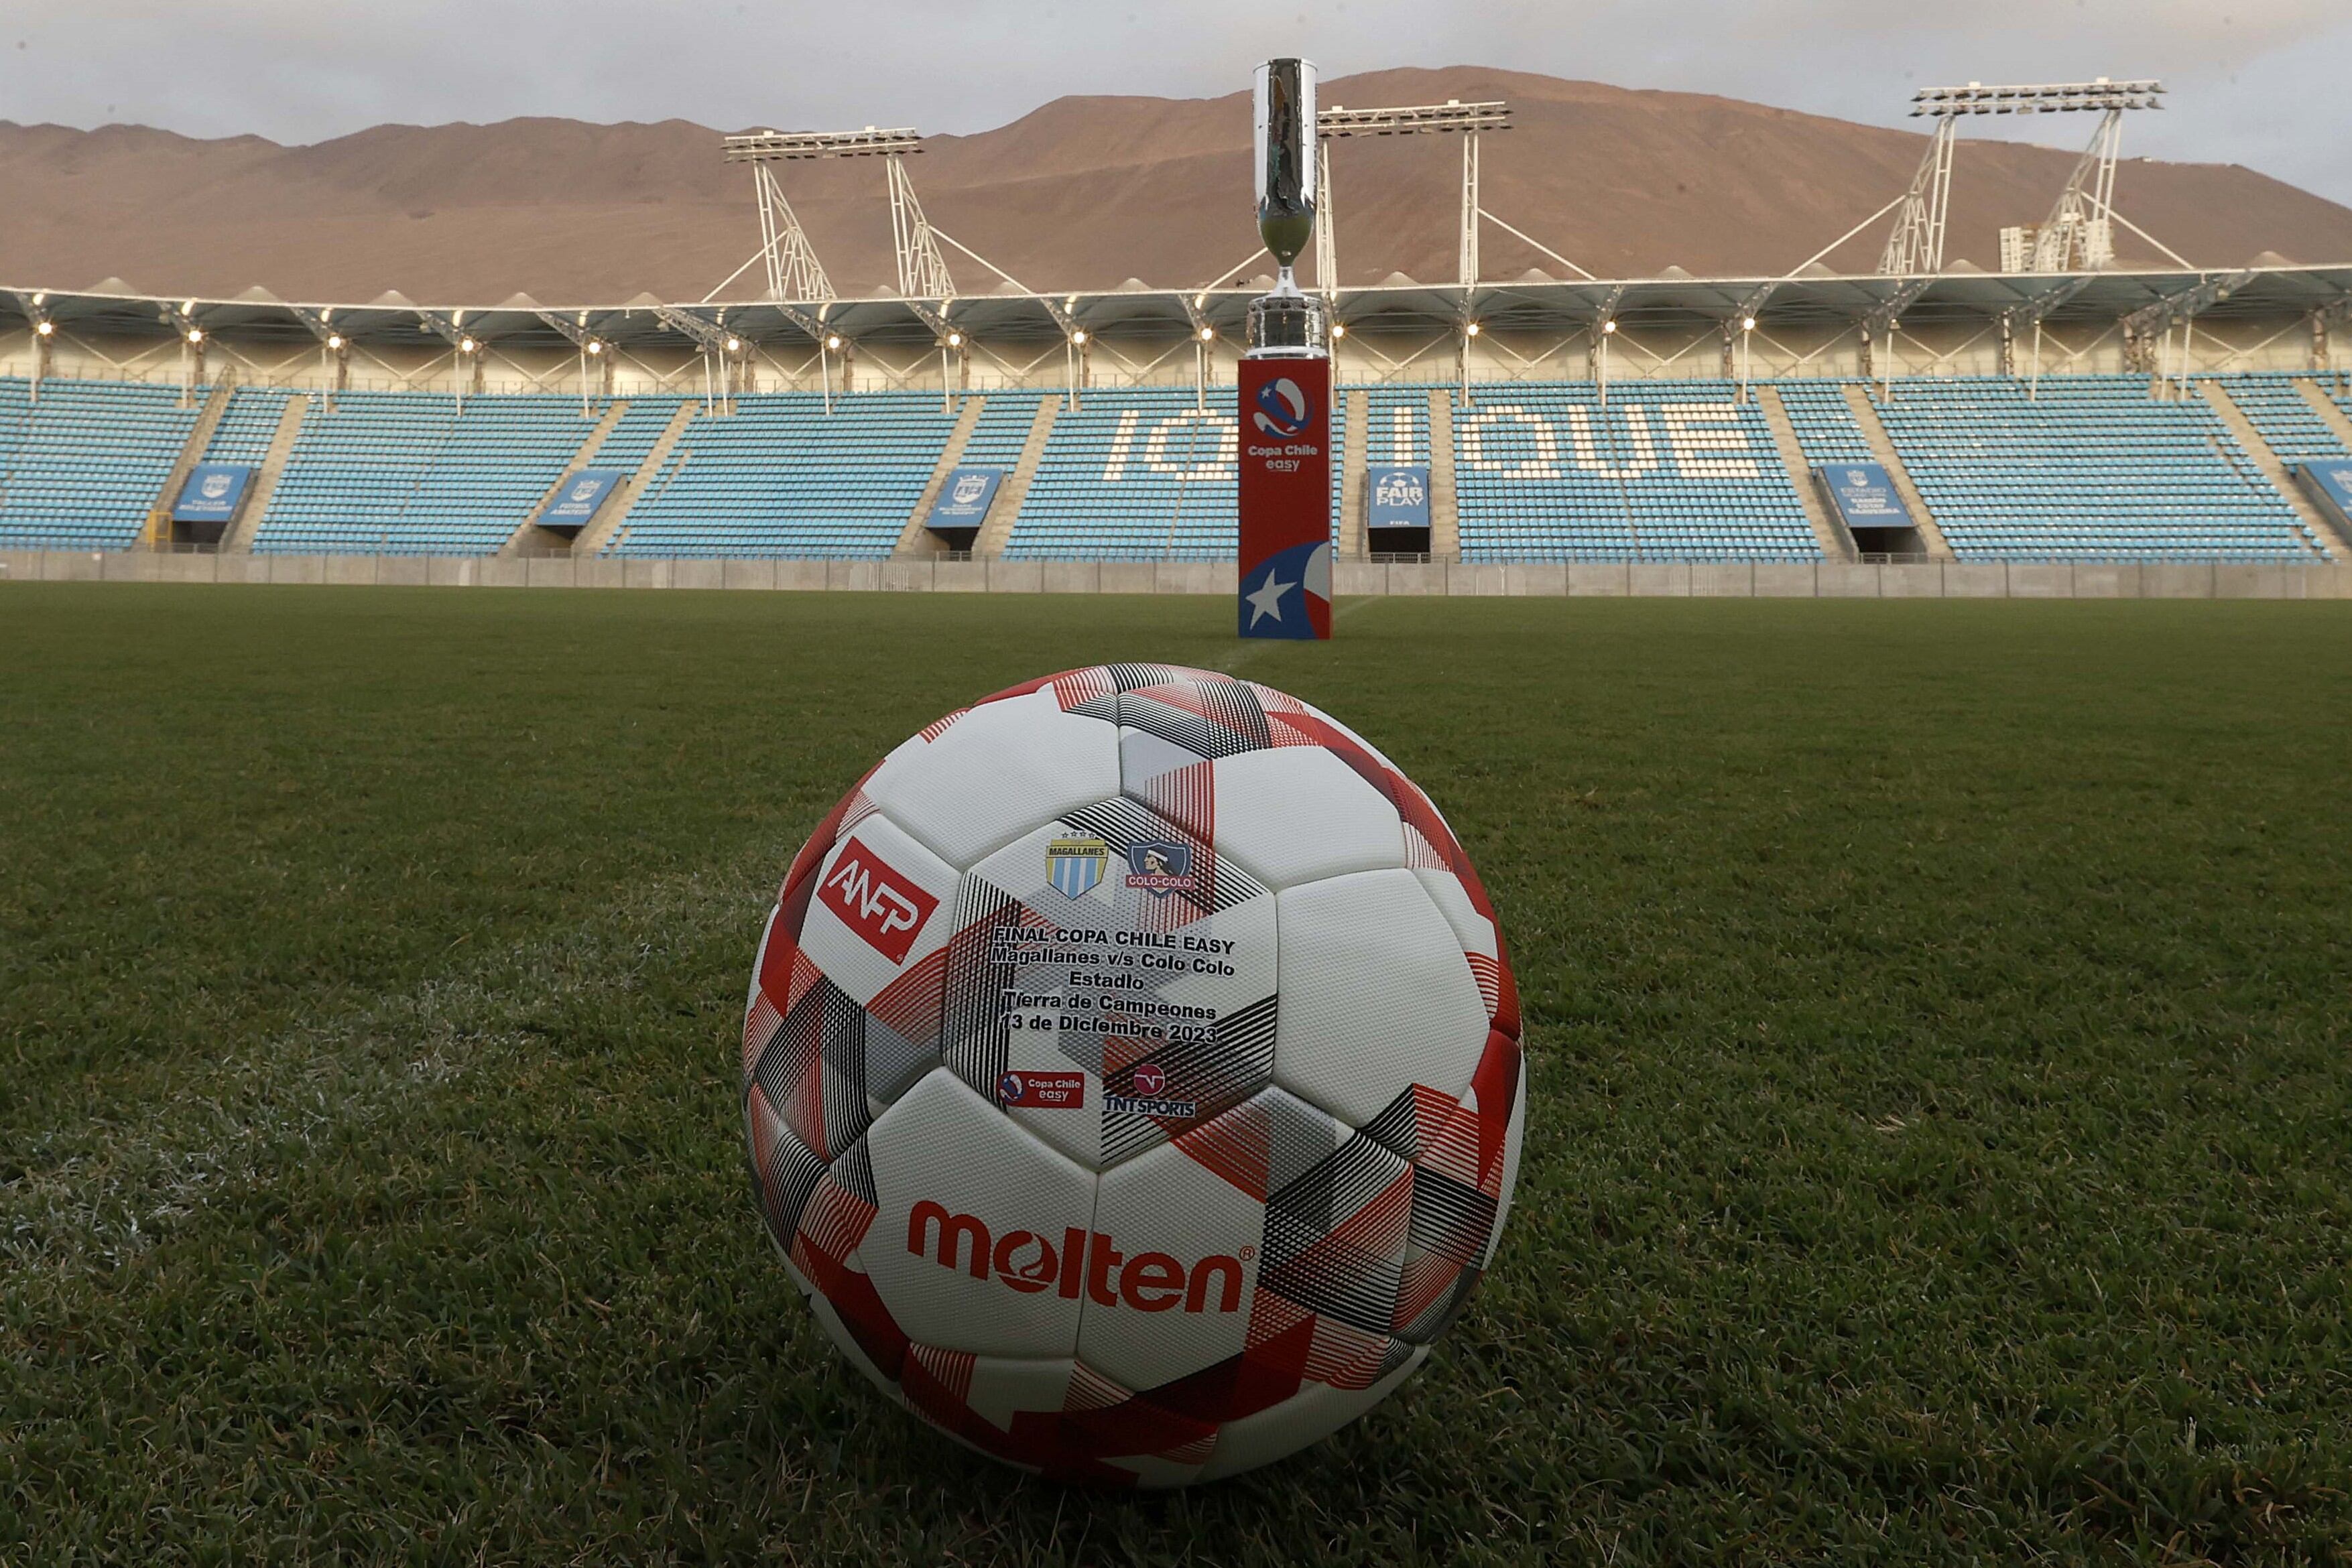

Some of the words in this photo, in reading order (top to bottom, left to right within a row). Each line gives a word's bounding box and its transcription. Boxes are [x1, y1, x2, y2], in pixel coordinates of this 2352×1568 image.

[1248, 445, 1282, 457] Copa
[1285, 445, 1318, 455] Chile
[1265, 460, 1300, 472] easy
[1376, 486, 1423, 498] FAIR
[1377, 497, 1424, 506] PLAY
[1049, 847, 1105, 856] MAGALLANES
[1128, 876, 1191, 888] COLO-COLO
[993, 927, 1049, 942] FINAL
[1056, 929, 1109, 945] COPA
[1115, 931, 1176, 950] CHILE
[1183, 936, 1235, 955] EASY
[991, 948, 1100, 966] Magallanes
[1107, 951, 1134, 966] v/s
[1141, 953, 1185, 971] Colo
[1192, 958, 1235, 976] Colo
[1070, 972, 1144, 990] Estadio
[1003, 991, 1061, 1008] Tierra
[1068, 994, 1092, 1009] de
[1099, 995, 1217, 1020] Campeones
[1001, 1012, 1023, 1029] 13
[1030, 1015, 1052, 1031] de
[1058, 1016, 1163, 1038] Diciembre
[1169, 1025, 1217, 1043] 2023
[1028, 1079, 1053, 1089] Copa
[1055, 1080, 1081, 1089] Chile
[1039, 1090, 1069, 1101] easy
